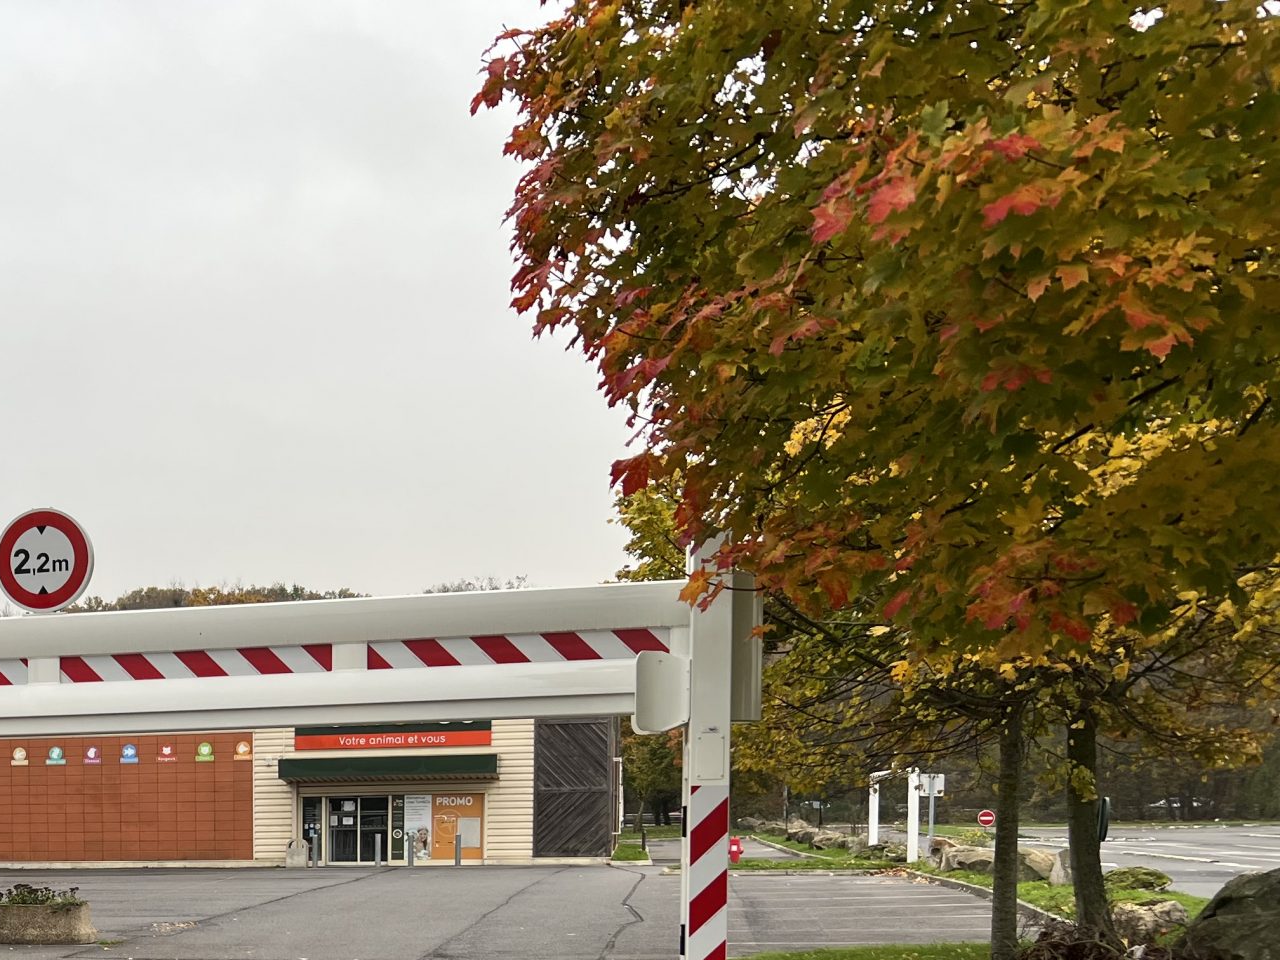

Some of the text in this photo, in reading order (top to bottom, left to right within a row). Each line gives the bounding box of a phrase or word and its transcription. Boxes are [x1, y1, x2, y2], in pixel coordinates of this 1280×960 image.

[338, 735, 446, 746] Votre animal et vous
[436, 796, 473, 806] PROMO
